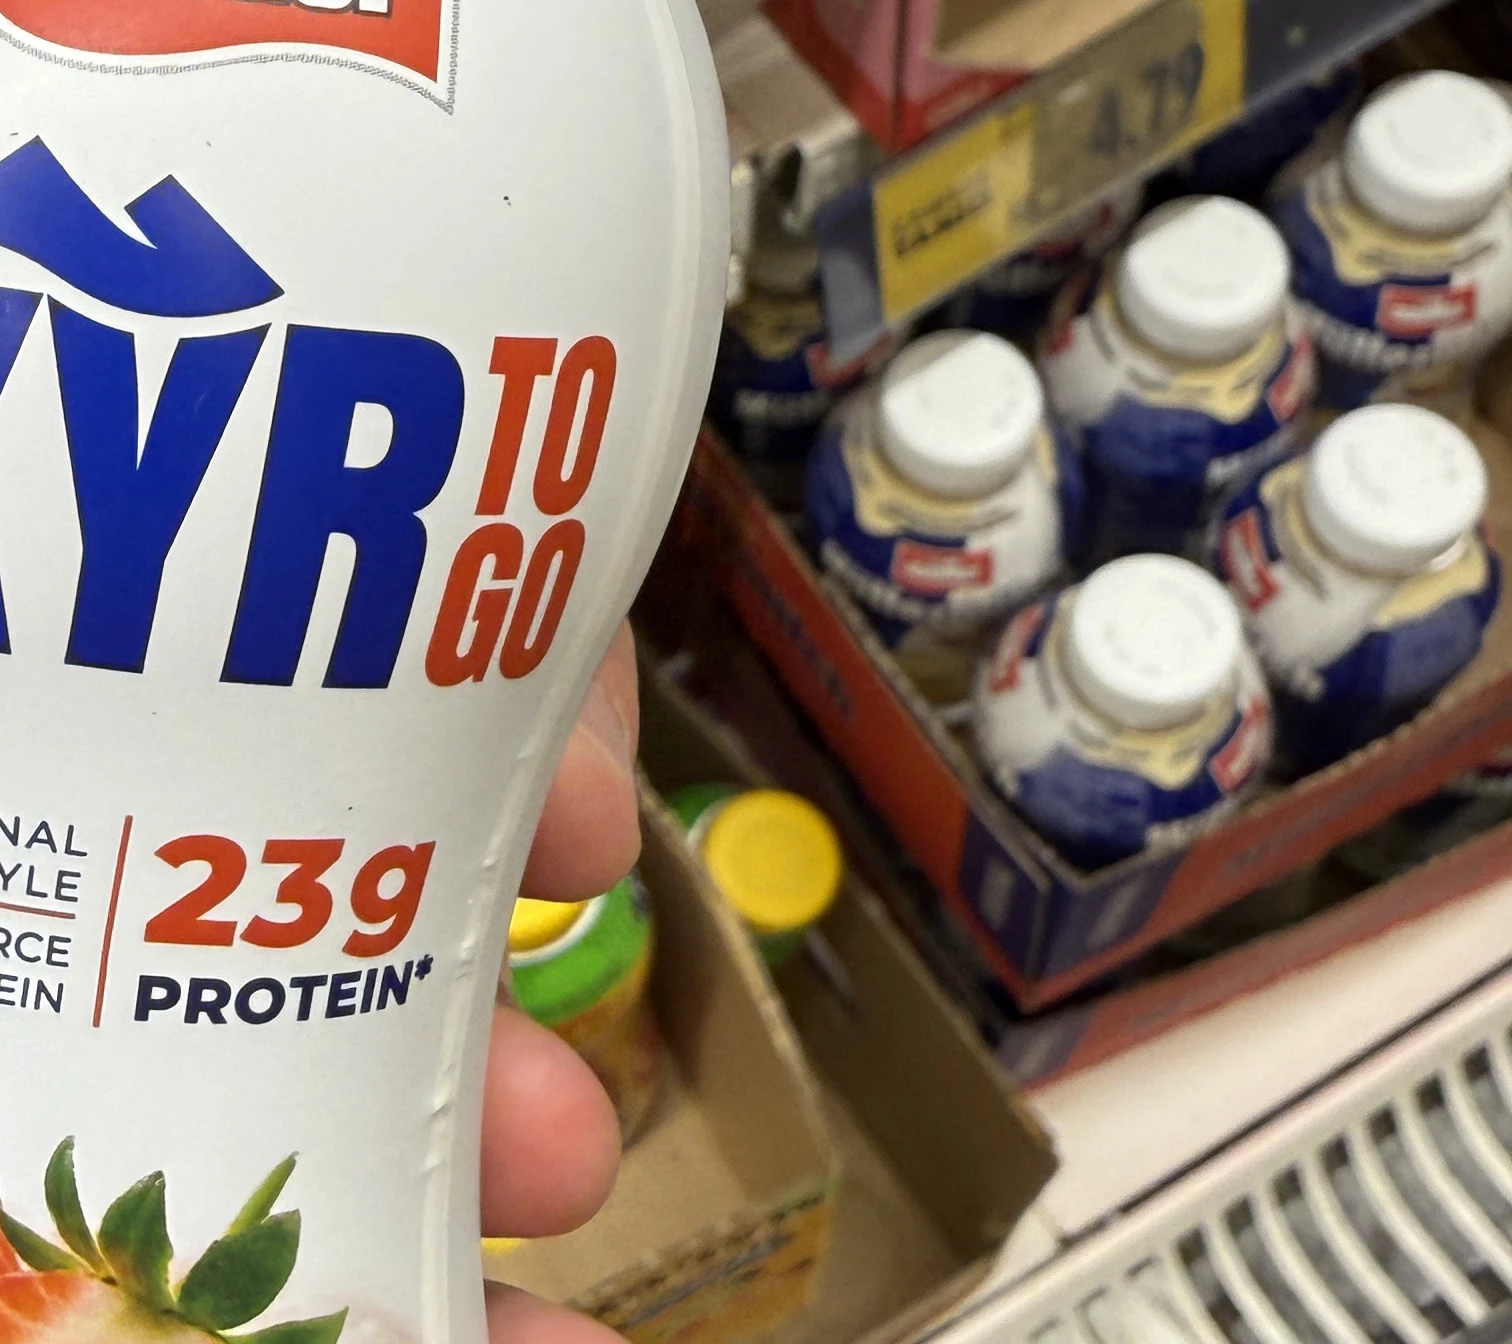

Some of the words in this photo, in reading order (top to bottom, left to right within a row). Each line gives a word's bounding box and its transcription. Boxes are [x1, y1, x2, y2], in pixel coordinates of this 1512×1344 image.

[474, 334, 617, 516] TO
[423, 518, 586, 688] GO
[144, 834, 437, 958] 23g
